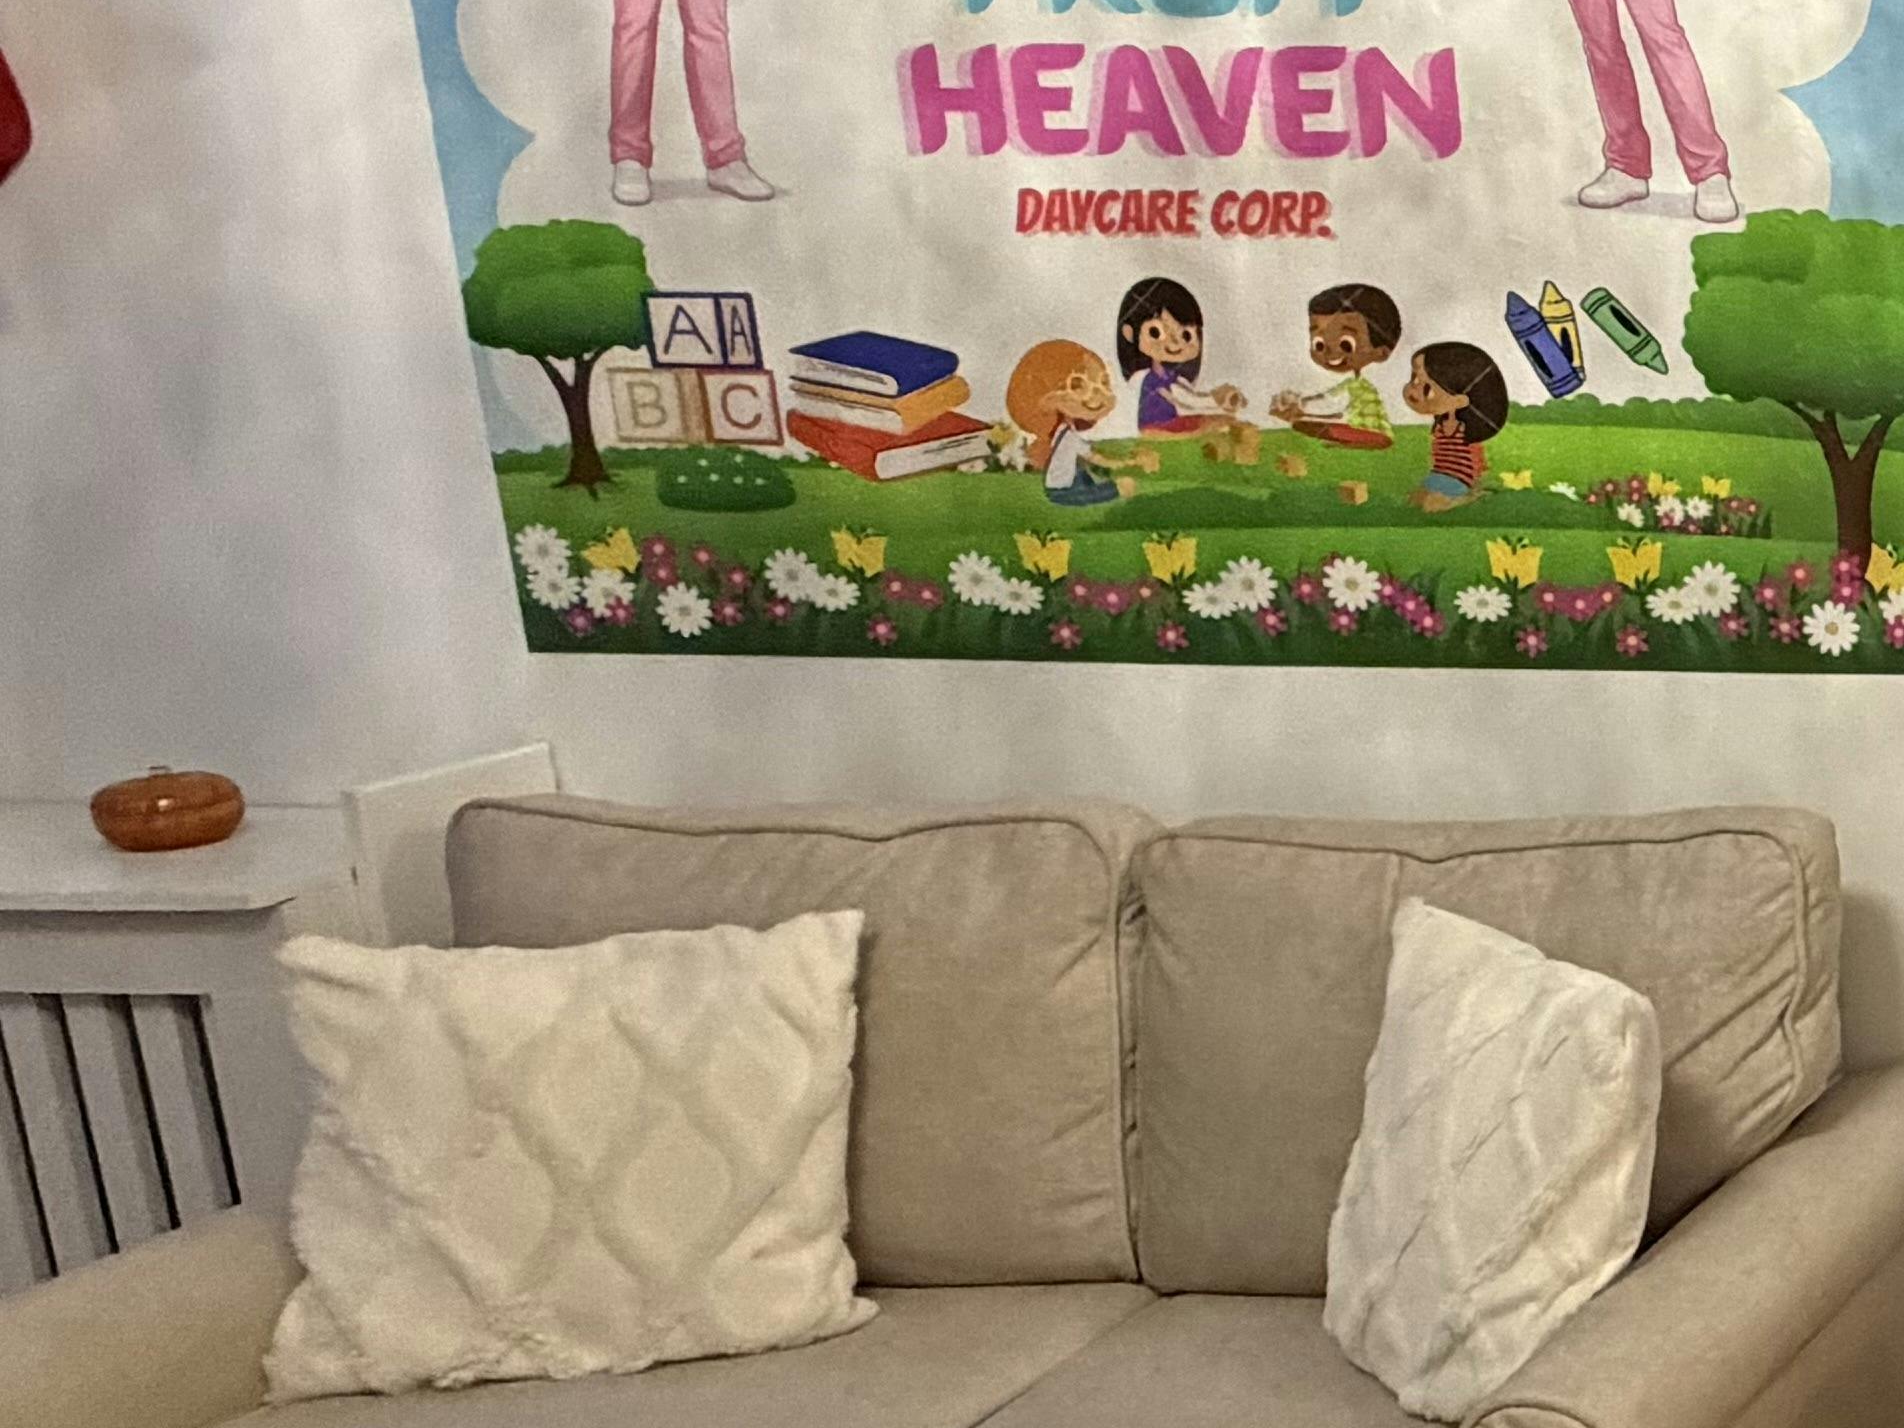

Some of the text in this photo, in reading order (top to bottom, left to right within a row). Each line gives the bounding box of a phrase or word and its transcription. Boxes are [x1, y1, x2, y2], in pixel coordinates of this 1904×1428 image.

[898, 42, 1464, 162] HEAVEN
[1015, 187, 1336, 239] DAYCARE CORP.
[666, 303, 714, 356] A
[632, 378, 762, 430] B C
